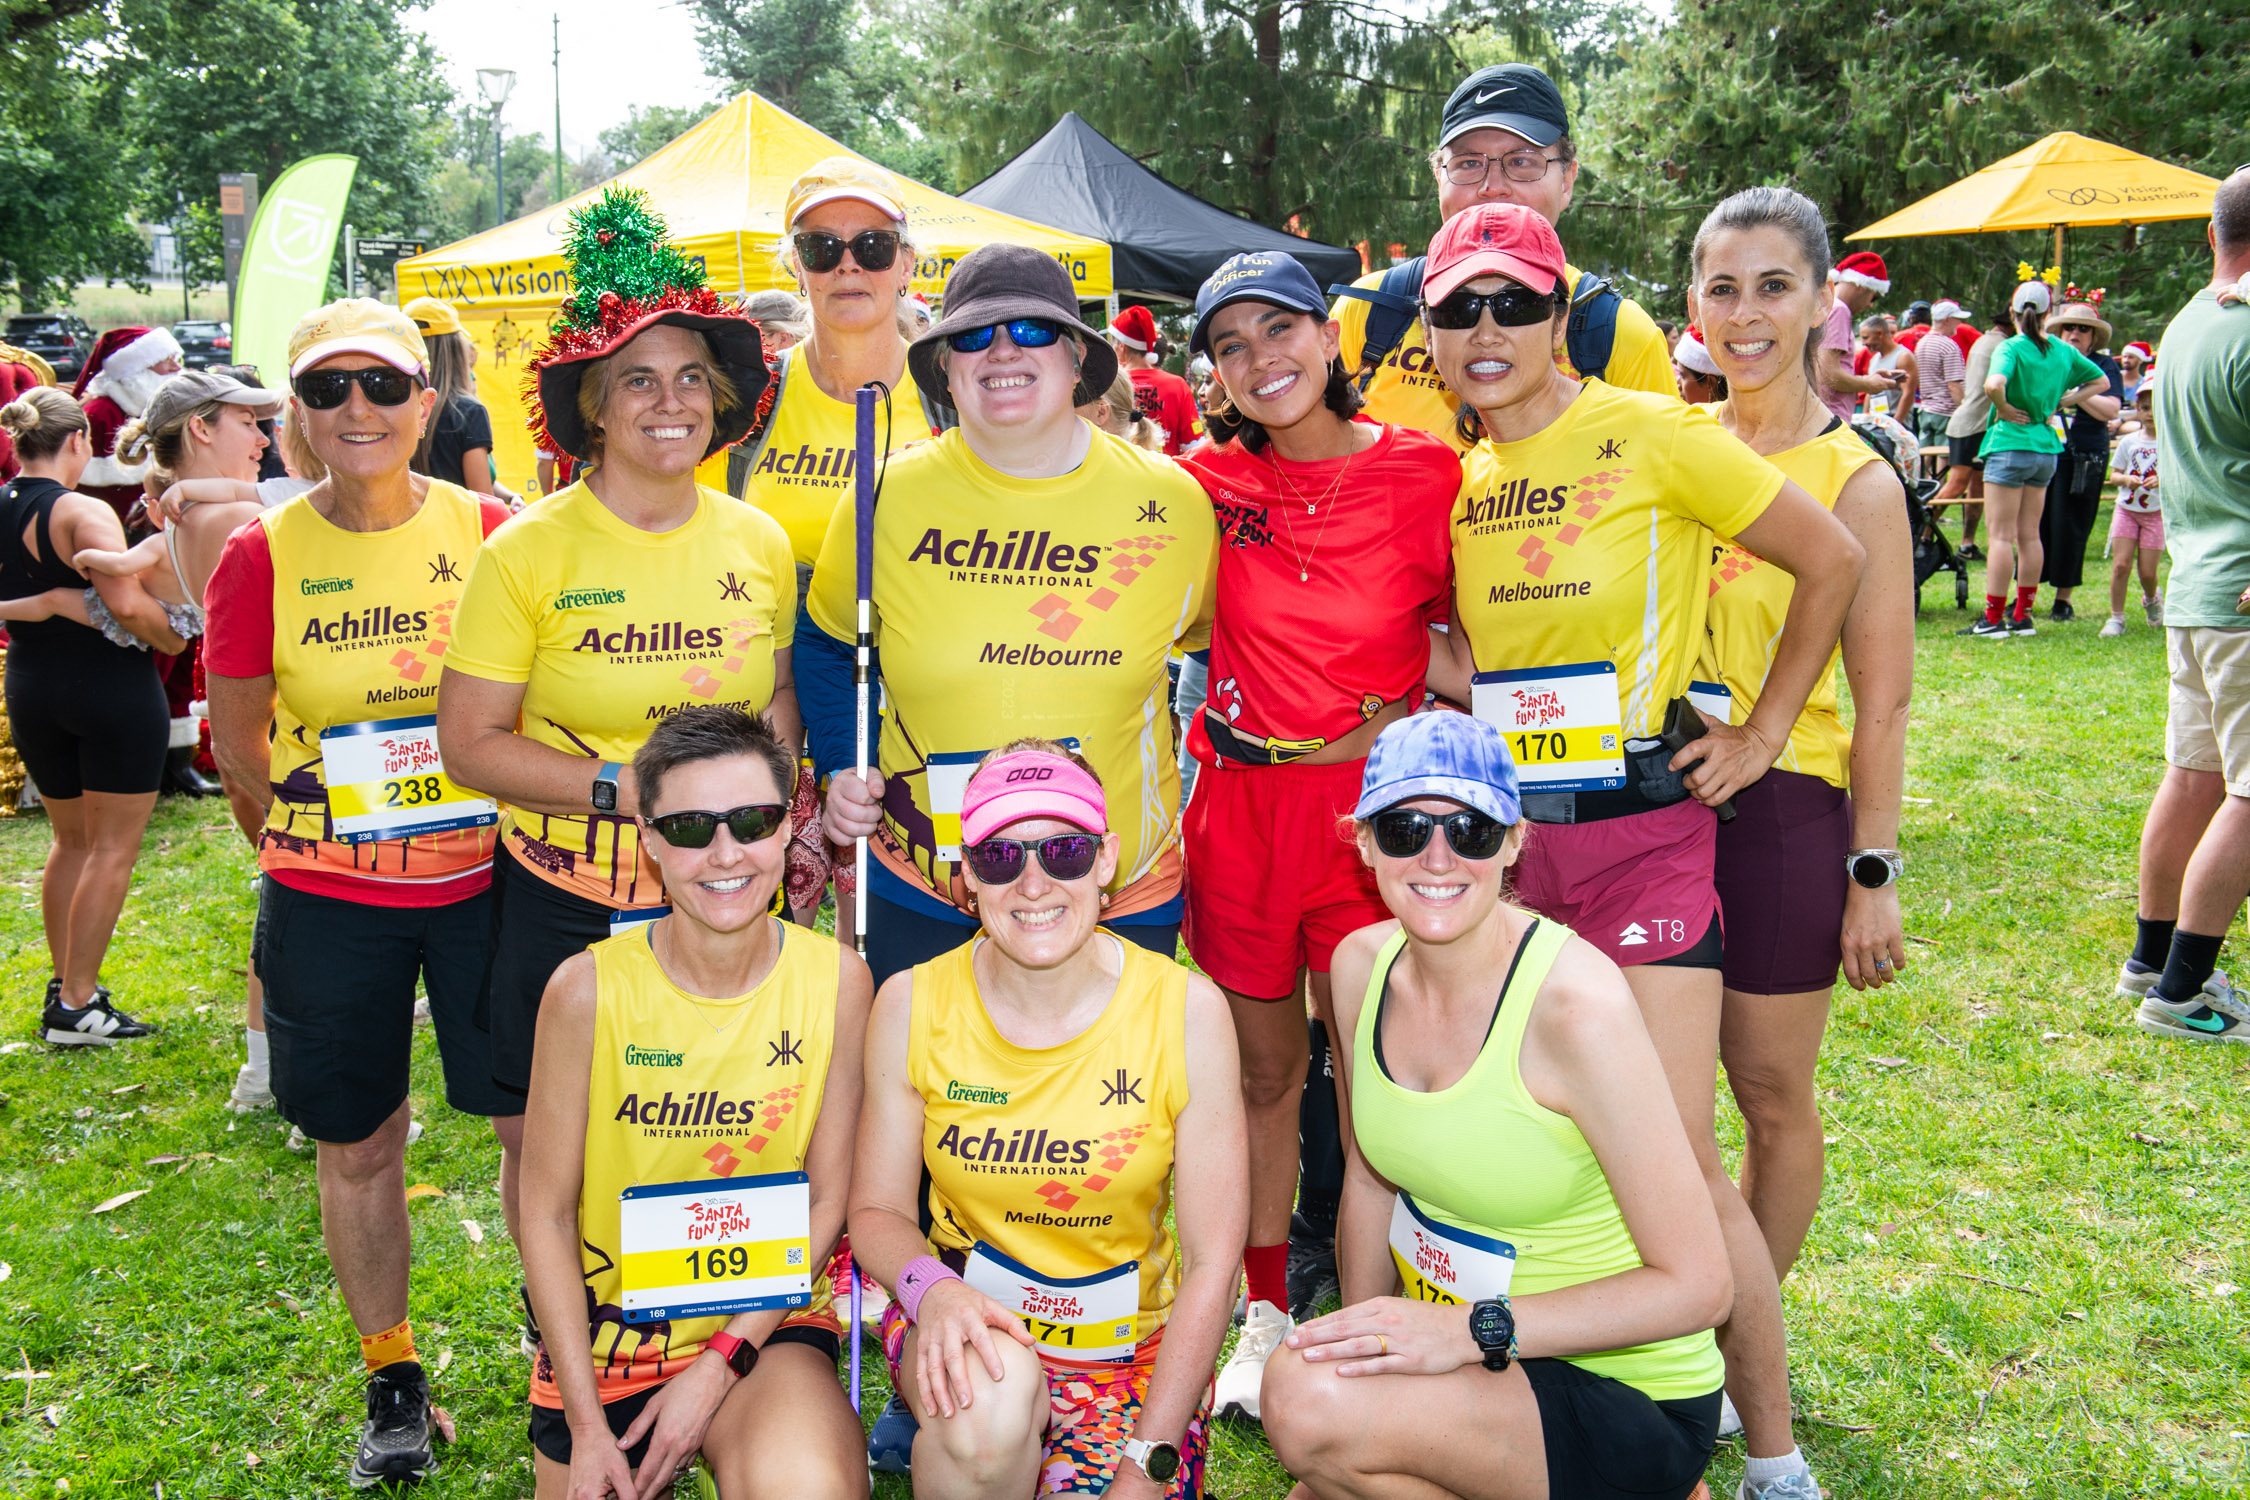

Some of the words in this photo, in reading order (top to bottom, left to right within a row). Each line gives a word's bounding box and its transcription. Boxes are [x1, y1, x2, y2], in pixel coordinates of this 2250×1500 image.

[2117, 185, 2169, 194] Vision
[2127, 190, 2200, 202] Australia
[1242, 258, 1273, 266] Fun
[486, 262, 569, 296] Vision
[1211, 269, 1265, 294] Officer
[754, 444, 856, 478] Achill
[777, 476, 849, 489] INTERNAT
[1307, 504, 1316, 515] B
[1456, 477, 1568, 527] Achilles
[1469, 515, 1562, 537] INTERNATIONAL
[908, 528, 1102, 574] Achilles
[301, 577, 354, 596] Greenies
[949, 570, 1094, 588] INTERNATIONAL
[554, 587, 625, 610] Greenies
[1488, 580, 1592, 604] Melbourne
[300, 605, 428, 645] Achilles
[330, 634, 428, 653] INTERNATIONAL
[573, 621, 724, 653] Achilles
[610, 650, 725, 665] INTERNATIONAL
[978, 642, 1123, 666] Melbourne
[366, 685, 438, 704] Melbour
[1518, 690, 1559, 709] SANTA
[1515, 709, 1536, 726] FUN
[1540, 705, 1565, 725] RUN
[388, 738, 431, 756] SANTA
[1516, 732, 1567, 761] 170
[384, 756, 409, 773] FUN
[412, 752, 439, 772] RUN
[384, 776, 442, 807] 238
[1602, 778, 1617, 787] 170
[476, 815, 490, 824] 238
[357, 832, 372, 841] 238
[1651, 919, 1685, 942] T8
[625, 1044, 683, 1067] Greenies
[947, 1079, 1008, 1105] Greenies
[614, 1090, 756, 1126] Achilles
[643, 1127, 751, 1138] INTERNATIONAL
[936, 1123, 1092, 1165] Achilles
[964, 1163, 1088, 1176] INTERNATIONAL
[693, 1202, 744, 1222] SANTA
[1004, 1210, 1113, 1228] Melbourne
[688, 1223, 715, 1241] FUN
[719, 1217, 750, 1240] RUN
[685, 1246, 748, 1280] 169
[1419, 1238, 1450, 1267] SANTA
[1416, 1251, 1431, 1271] FUN
[1434, 1263, 1456, 1283] RUN
[786, 1296, 801, 1305] 169
[1029, 1289, 1078, 1307] SANTA
[649, 1309, 665, 1318] 169
[1022, 1300, 1049, 1314] FUN
[1053, 1306, 1084, 1319] RUN
